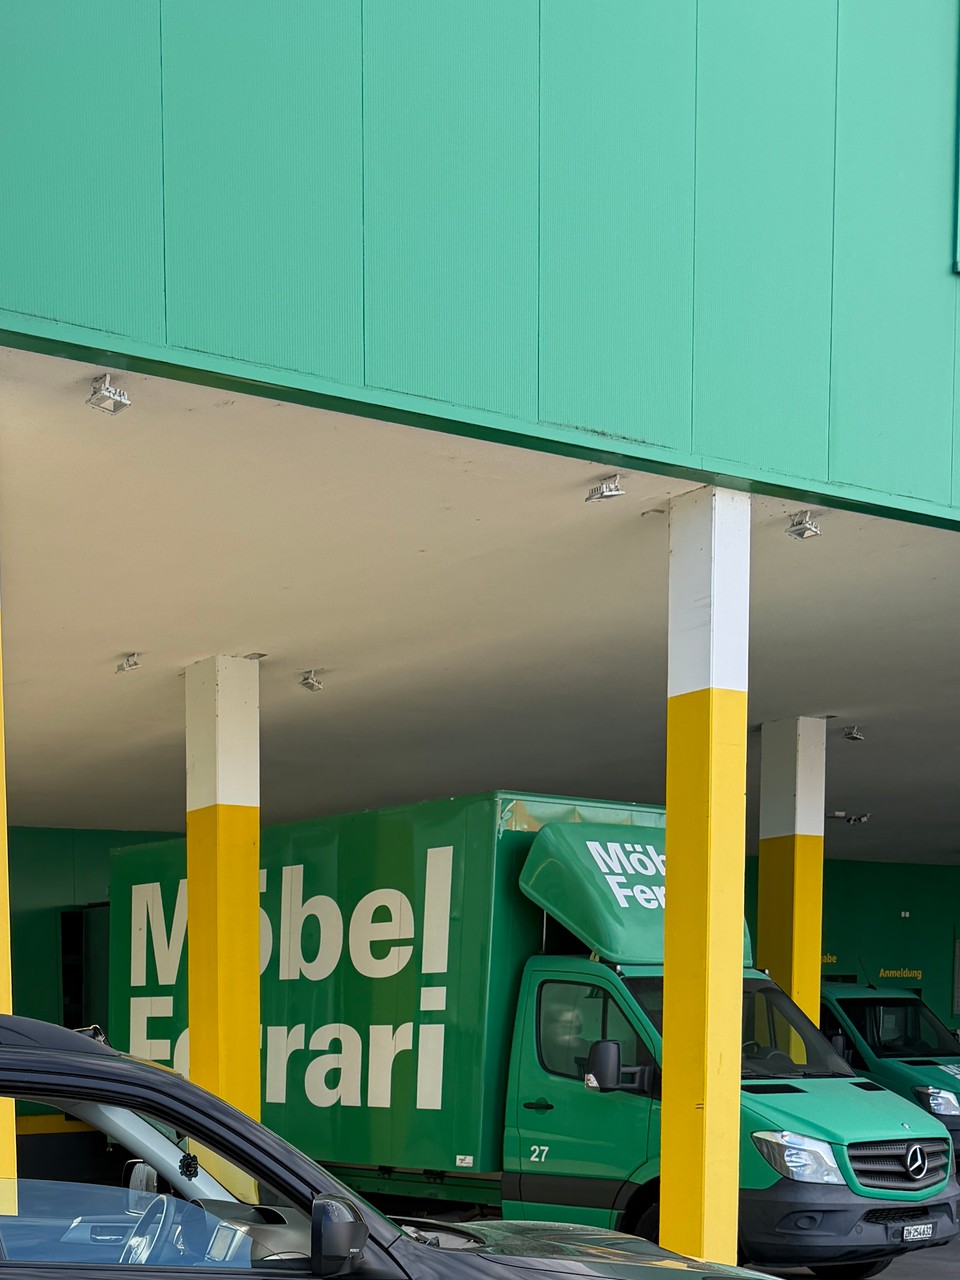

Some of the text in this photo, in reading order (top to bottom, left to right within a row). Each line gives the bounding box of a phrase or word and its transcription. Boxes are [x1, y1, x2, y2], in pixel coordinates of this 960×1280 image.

[586, 841, 666, 876] Möb
[604, 875, 666, 909] Fer
[130, 846, 454, 987] Mbel
[821, 953, 837, 963] abe
[879, 968, 922, 980] Anmeldung
[129, 986, 447, 1110] Frari
[530, 1145, 549, 1162] 27
